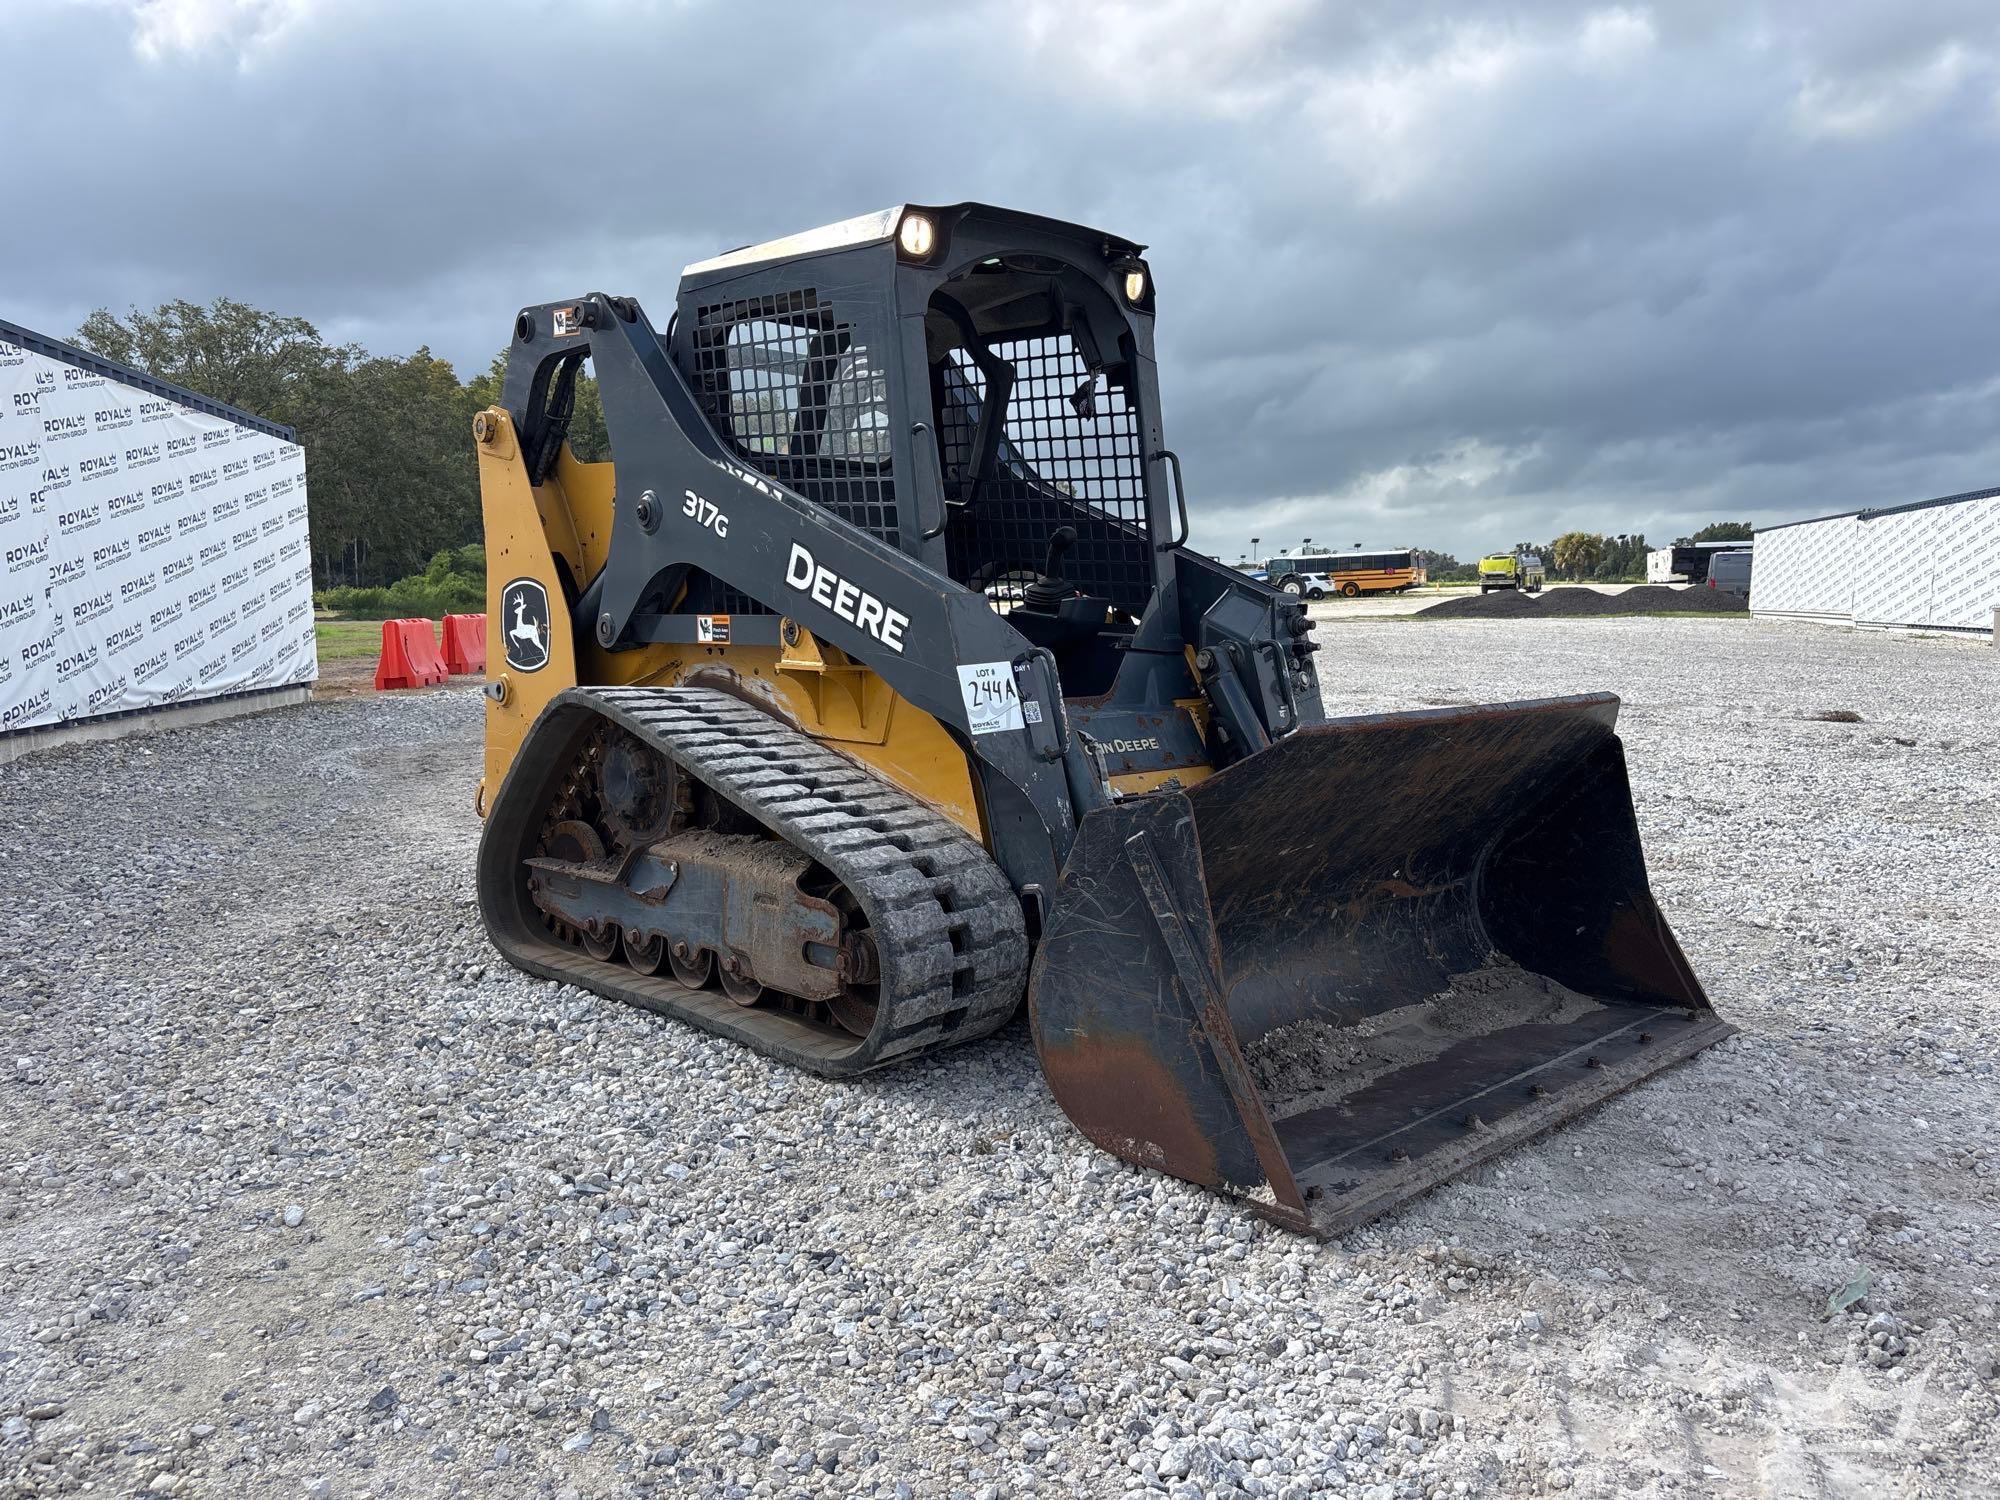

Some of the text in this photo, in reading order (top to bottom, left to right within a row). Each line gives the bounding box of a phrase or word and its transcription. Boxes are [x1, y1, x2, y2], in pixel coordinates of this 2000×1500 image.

[4, 359, 24, 367] GROUP
[67, 382, 88, 390] AUCTION
[14, 392, 38, 406] ROY
[17, 407, 40, 416] AUCTIO
[95, 408, 124, 423] ROYAL
[140, 401, 166, 415] ROYAL
[44, 417, 78, 432] ROYAL
[235, 425, 248, 433] ROY
[47, 429, 87, 442] AUCTION GROUP
[203, 429, 224, 441] ROYAL
[0, 445, 28, 461] OYAL
[126, 446, 152, 461] ROYAL
[167, 440, 190, 451] ROYAL
[0, 457, 39, 471] CTION GROUP
[80, 456, 109, 473] ROYAL
[223, 461, 243, 474] ROYAL
[43, 468, 61, 482] YAL
[82, 473, 102, 481] AUCTION
[190, 470, 211, 484] ROYAL
[297, 473, 306, 482] ROY
[53, 480, 71, 490] GROUP
[152, 481, 176, 497] ROYAL
[108, 494, 136, 510] ROYAL
[213, 500, 233, 515] ROYAL
[59, 508, 92, 527] ROYAL
[178, 513, 201, 529] ROYAL
[683, 490, 729, 538] 317G
[62, 518, 101, 535] AUCTION GROUP
[138, 527, 164, 544] ROYAL
[6, 542, 44, 564] ROYAL
[94, 543, 122, 562] ROYAL
[200, 543, 221, 559] ROYAL
[9, 554, 49, 574] AUCTION GRO
[50, 561, 75, 579] OYAL
[163, 558, 187, 576] ROYAL
[50, 571, 86, 588] TION GROUP
[121, 576, 149, 596] ROYAL
[222, 571, 243, 587] ROYAL
[189, 586, 210, 605] ROYAL
[786, 543, 909, 653] DEERE
[0, 600, 24, 620] YAL
[73, 596, 105, 618] ROYAL
[150, 605, 175, 625] ROYAL
[0, 610, 35, 630] TION GROUP
[76, 613, 97, 626] AUCTION
[210, 614, 231, 632] ROYAL
[107, 627, 135, 648] ROYAL
[303, 627, 314, 640] ROY
[22, 638, 55, 661] ROYA
[174, 635, 197, 653] ROYAL
[26, 653, 50, 671] AUCTION
[82, 658, 98, 671] GROUP
[134, 656, 160, 678] ROYAL
[200, 659, 221, 677] ROYAL
[0, 673, 12, 684] OUP
[976, 669, 989, 677] LOT
[89, 680, 118, 706] ROYAL
[968, 678, 1015, 707] 244A
[3, 695, 41, 724] ROYAL
[32, 703, 52, 718] GROUP
[1115, 739, 1159, 753] DEERE
